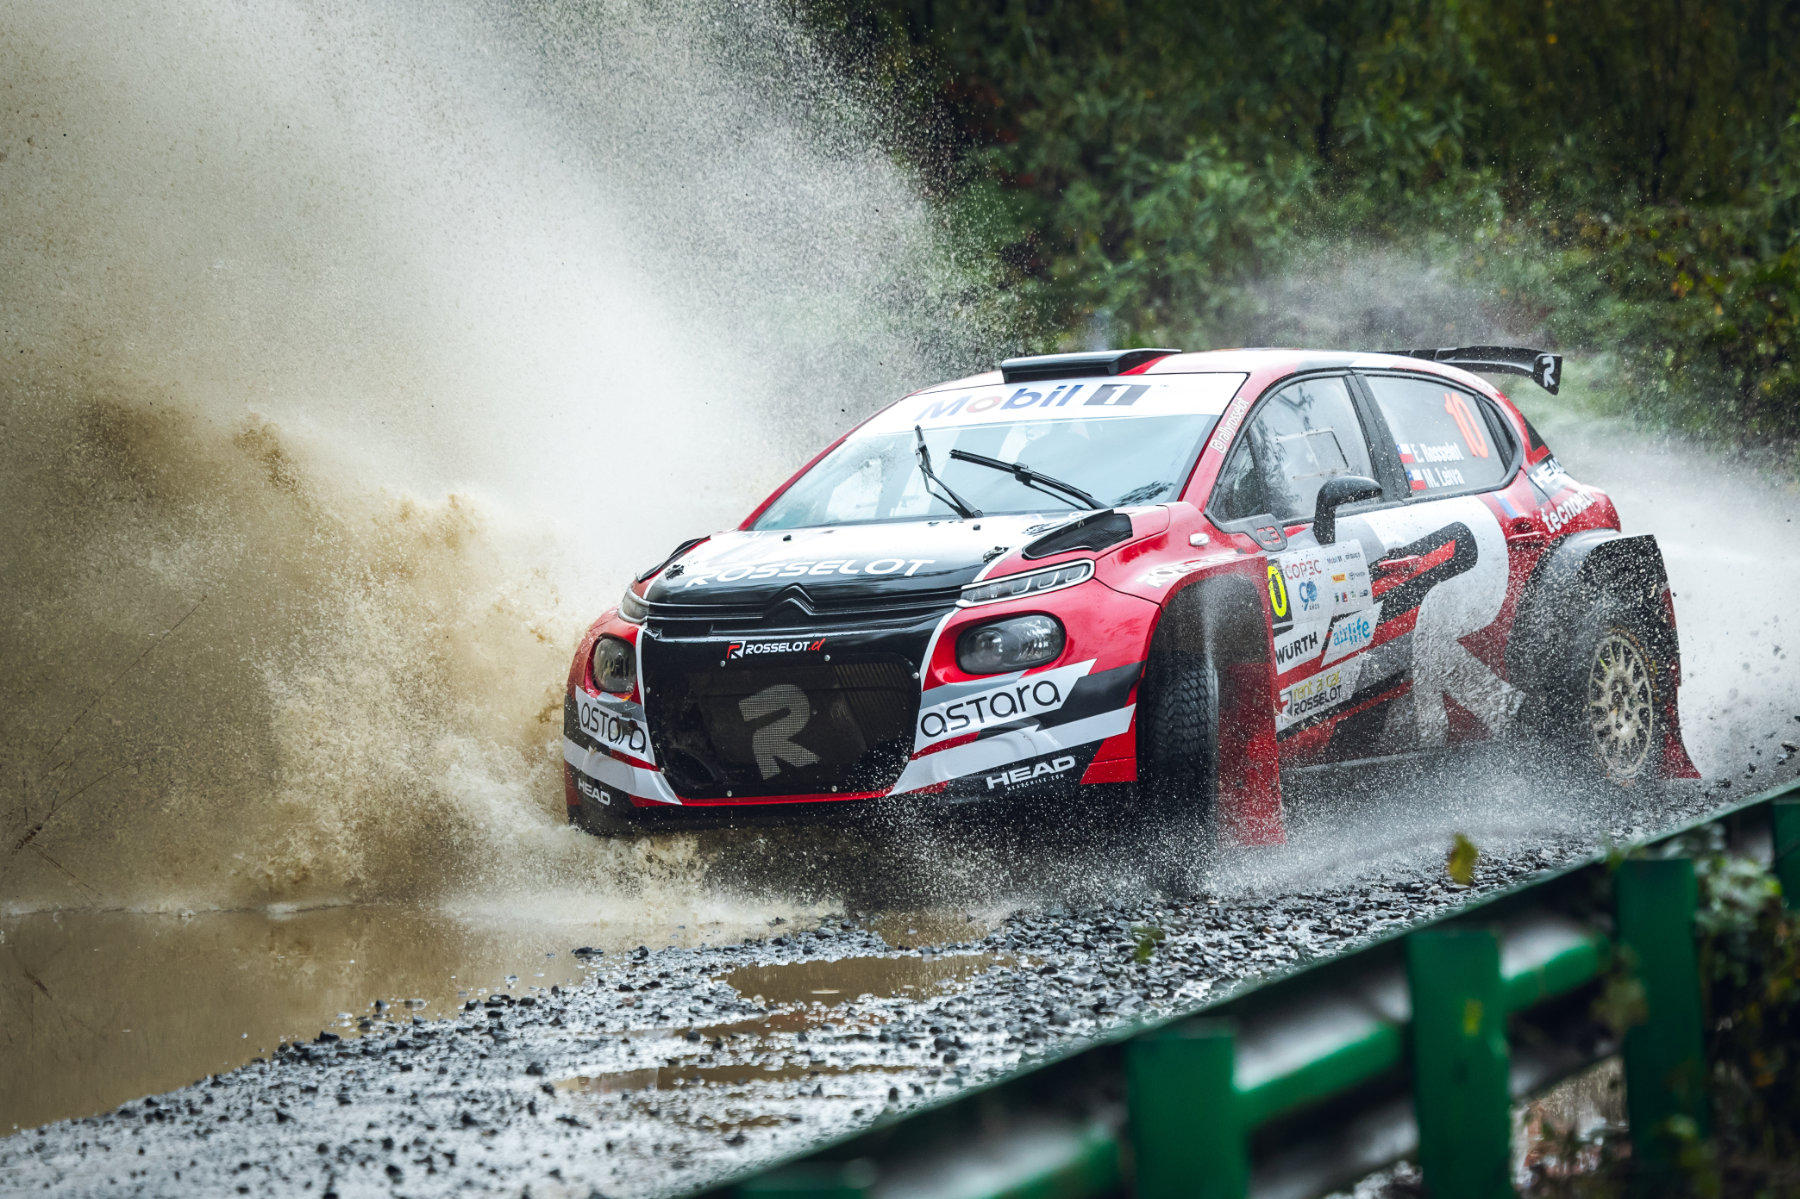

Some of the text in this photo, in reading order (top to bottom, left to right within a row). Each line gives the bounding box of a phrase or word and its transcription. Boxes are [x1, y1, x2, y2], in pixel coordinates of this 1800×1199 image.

[914, 384, 1084, 421] Mobil
[1443, 392, 1488, 458] 10
[1530, 457, 1565, 488] HEA
[684, 558, 936, 587] ROSSELOT
[1267, 566, 1287, 617] 0
[1275, 631, 1319, 665] WÜRTH
[1293, 681, 1313, 701] rent
[1293, 685, 1342, 717] ROSSELOT
[920, 680, 1062, 738] astara
[581, 702, 647, 754] astara
[986, 755, 1076, 790] HEAD
[578, 778, 611, 806] HEAD
